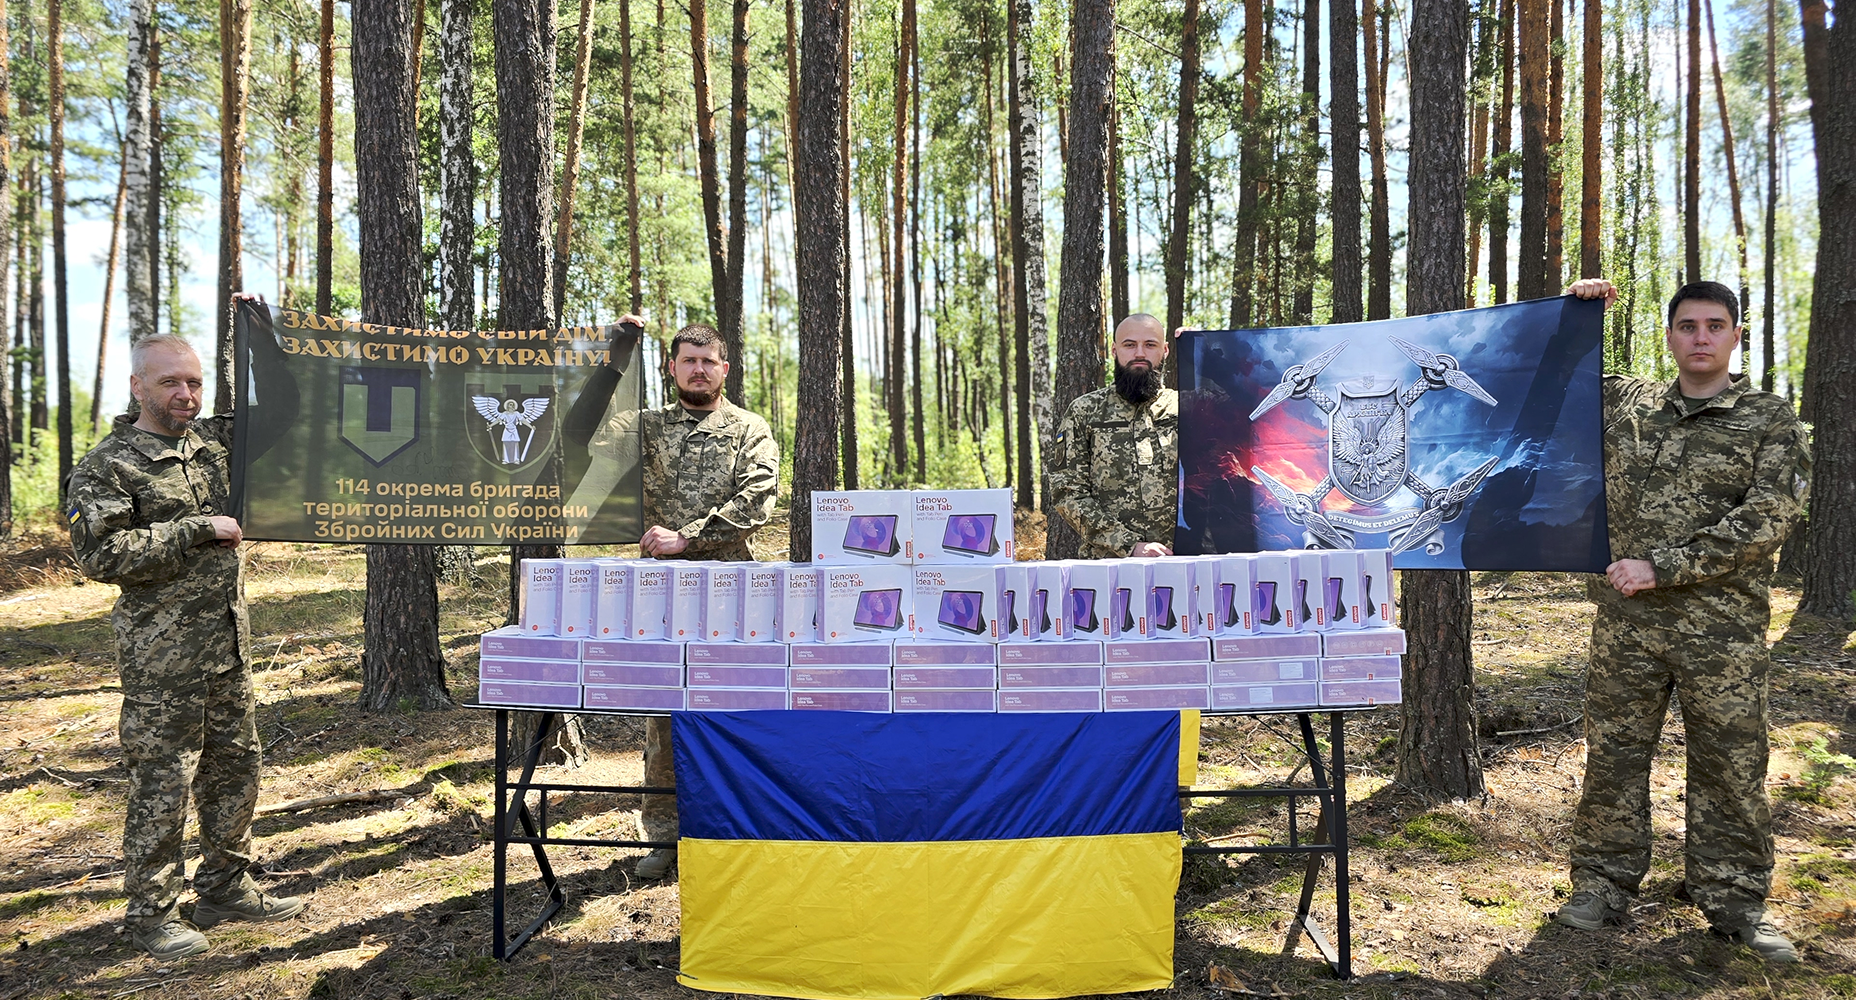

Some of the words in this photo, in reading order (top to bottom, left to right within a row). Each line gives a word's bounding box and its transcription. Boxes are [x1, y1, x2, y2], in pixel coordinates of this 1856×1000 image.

[282, 335, 470, 365] ЗАХИСТИМО
[476, 345, 612, 367] УКРАЇНУ!
[335, 478, 370, 495] 114
[376, 482, 464, 500] окрема
[470, 481, 560, 500] бригада
[303, 500, 489, 520] територіальної
[493, 502, 588, 521] оборони
[838, 504, 854, 512] Tab
[1383, 511, 1420, 527] DELEMUS
[314, 520, 435, 541] Збройних
[441, 522, 485, 539] Сил
[490, 522, 578, 542] України
[830, 573, 859, 581] Lenovo
